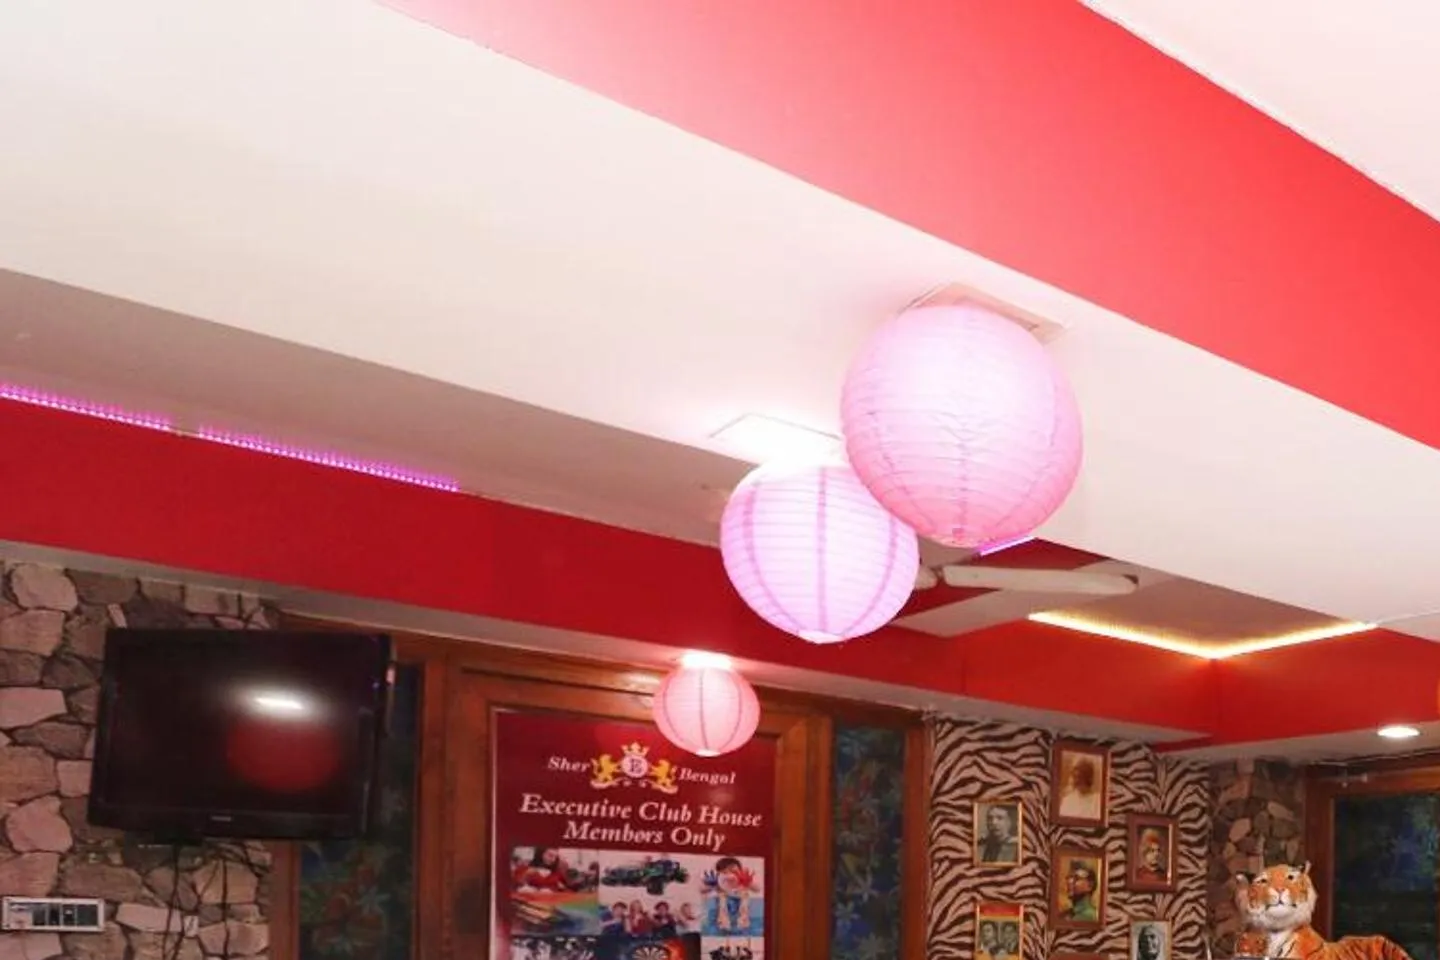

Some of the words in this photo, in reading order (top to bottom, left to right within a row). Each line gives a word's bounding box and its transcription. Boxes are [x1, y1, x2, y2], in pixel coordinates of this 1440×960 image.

[547, 756, 590, 773] Sher
[678, 767, 736, 785] Bengal
[518, 793, 632, 819] Executive
[639, 802, 692, 822] Club
[697, 805, 762, 827] House
[563, 820, 664, 845] Members
[670, 827, 725, 851] Only
